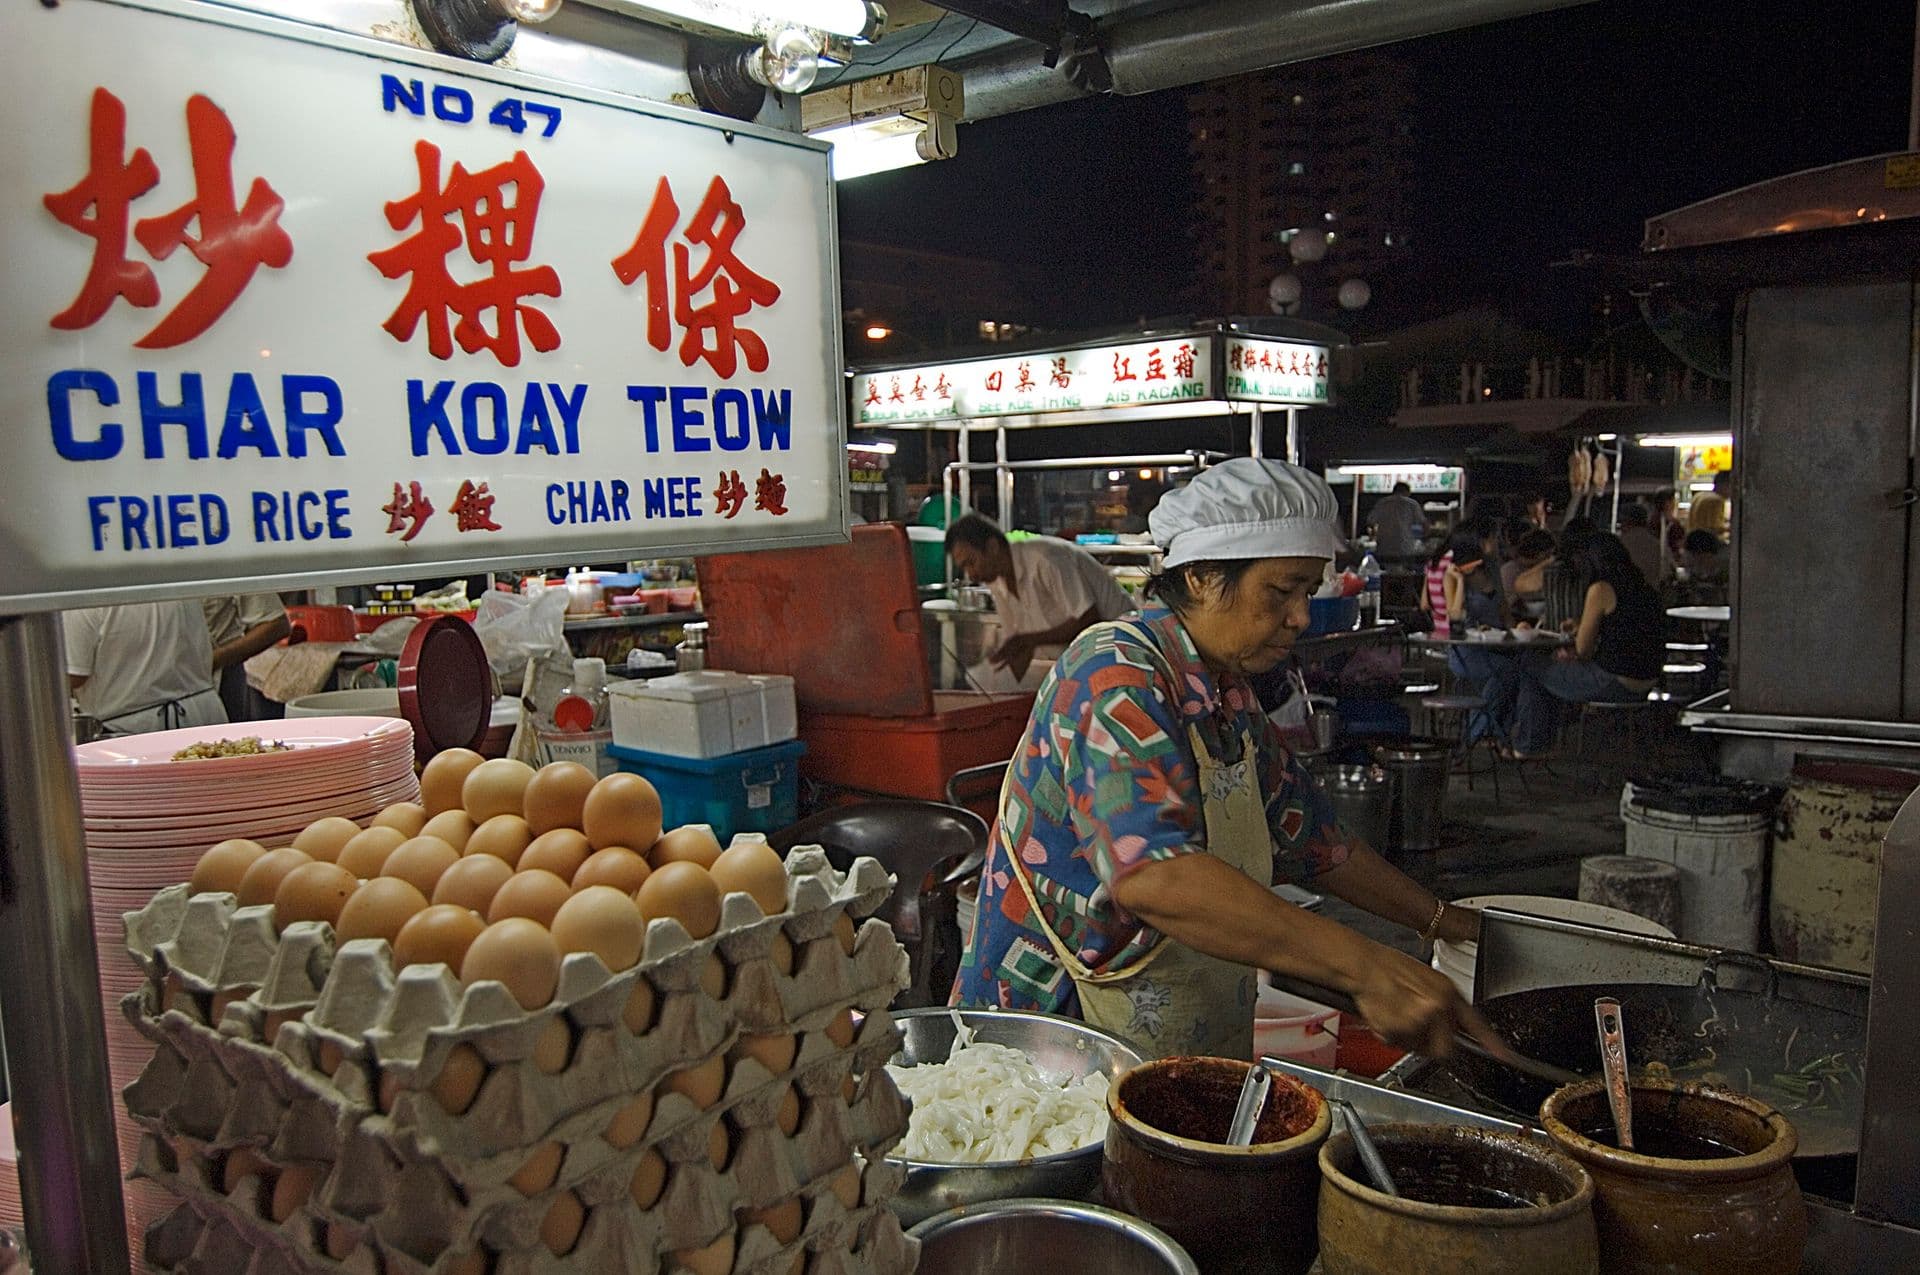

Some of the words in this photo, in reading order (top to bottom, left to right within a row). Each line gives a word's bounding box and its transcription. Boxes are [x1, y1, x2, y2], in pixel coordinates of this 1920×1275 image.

[380, 75, 473, 124] NO
[489, 98, 562, 138] 47
[48, 369, 346, 461] CHAR
[406, 379, 588, 457] KOAY
[626, 385, 792, 453] TEOW
[1106, 388, 1130, 403] AIS
[1138, 382, 1204, 400] KACANG
[88, 493, 230, 551] FRIED
[251, 489, 352, 542] RICE
[381, 479, 502, 541] 炒飯
[546, 480, 631, 525] CHAR
[644, 477, 703, 519] MEE
